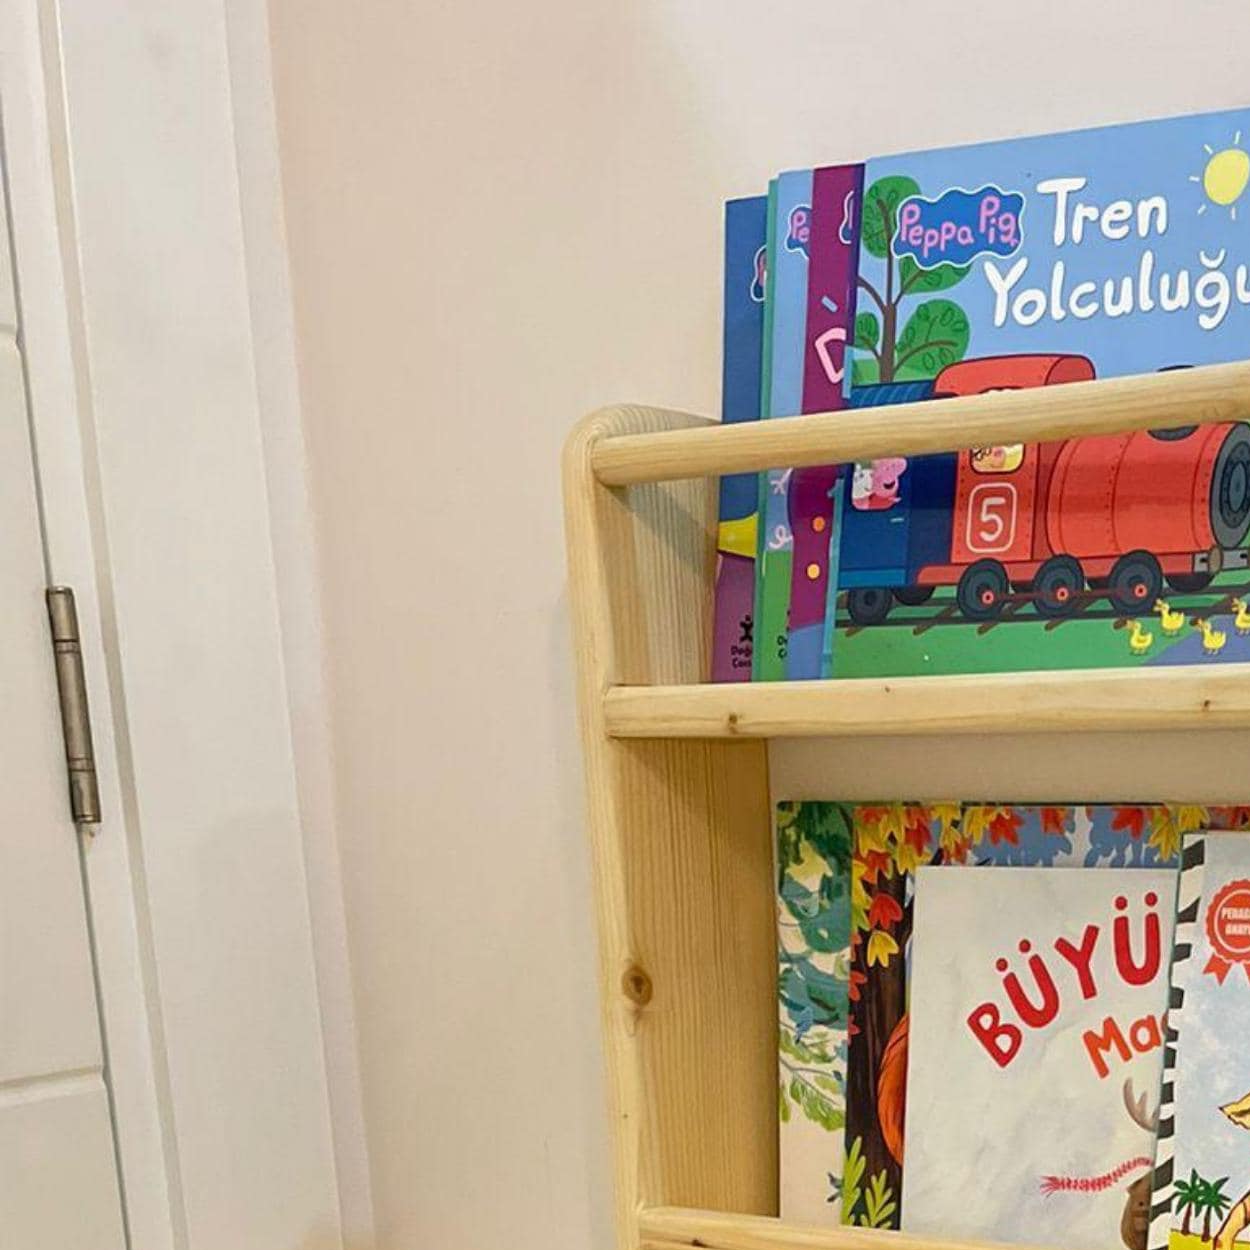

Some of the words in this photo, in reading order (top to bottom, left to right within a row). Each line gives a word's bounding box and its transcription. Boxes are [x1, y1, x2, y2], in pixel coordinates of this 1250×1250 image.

[901, 203, 974, 258] Peppa
[979, 196, 1019, 247] Pig
[1037, 177, 1168, 246] Tren
[978, 496, 1004, 543] 5
[966, 892, 1161, 1069] BÜYÜ
